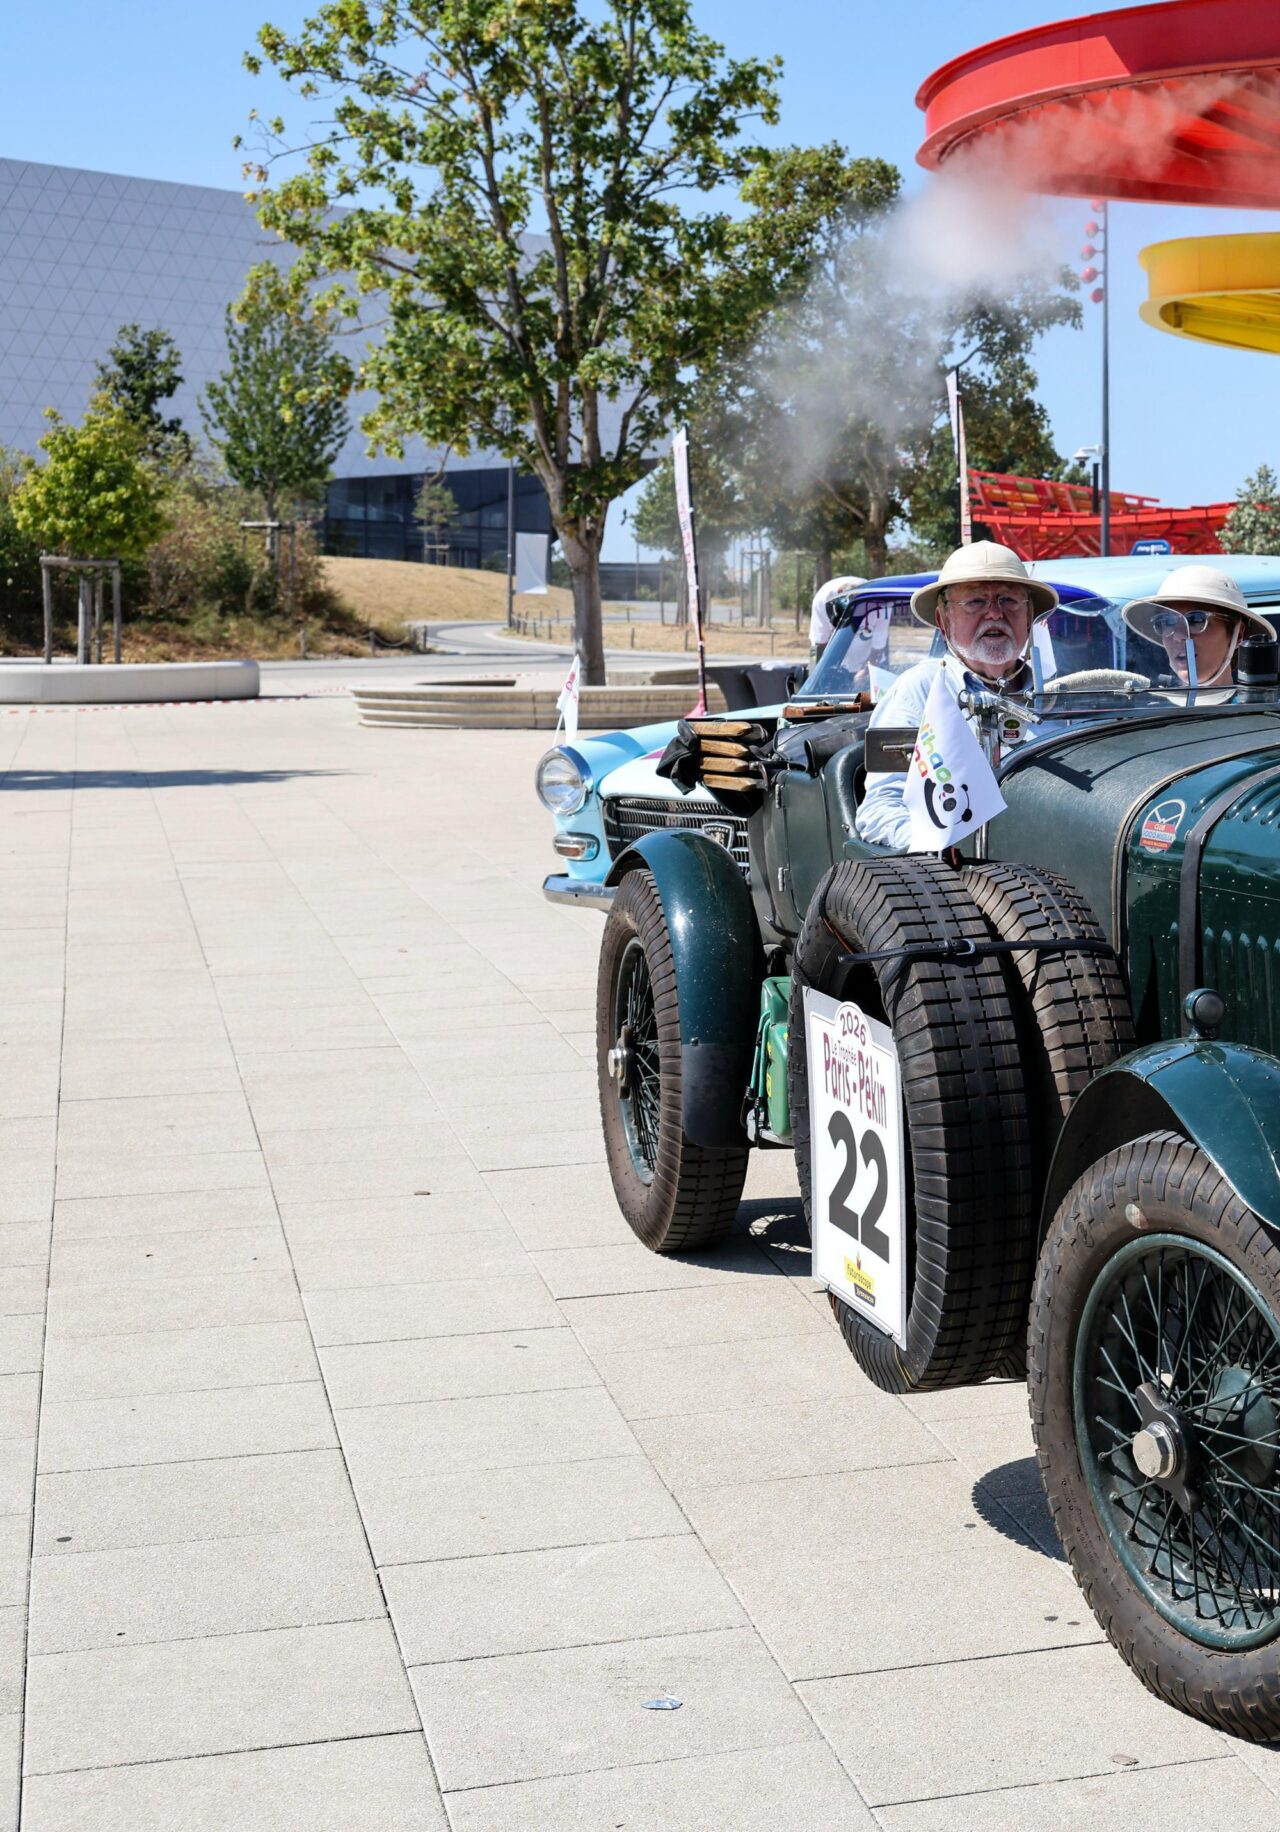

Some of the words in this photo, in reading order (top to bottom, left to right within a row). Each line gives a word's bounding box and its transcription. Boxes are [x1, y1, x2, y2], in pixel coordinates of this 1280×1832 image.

[840, 1011, 866, 1046] 2026
[823, 1032, 851, 1107] Paris
[858, 1050, 887, 1129] Pékin
[828, 1110, 890, 1264] 22
